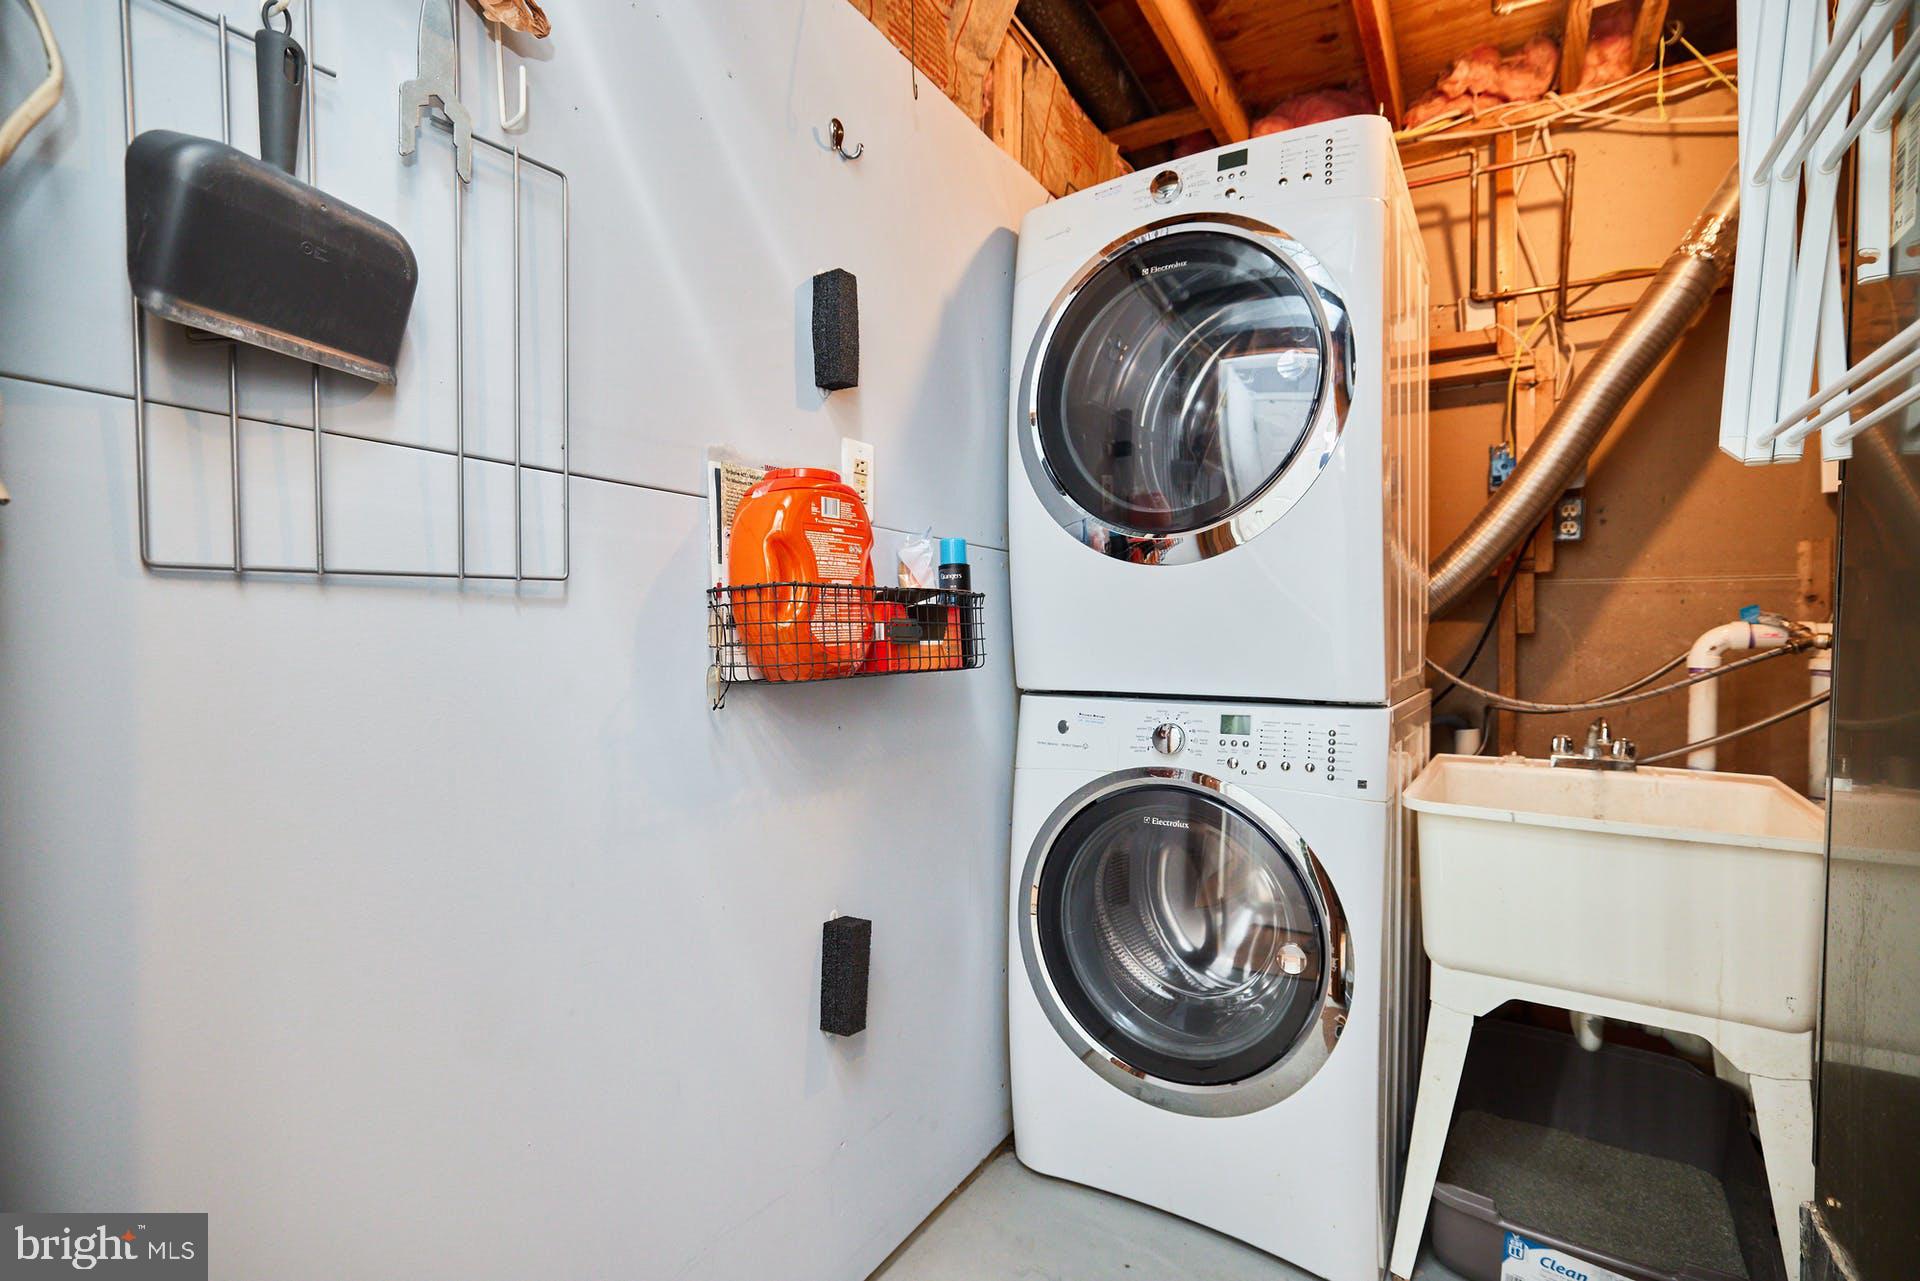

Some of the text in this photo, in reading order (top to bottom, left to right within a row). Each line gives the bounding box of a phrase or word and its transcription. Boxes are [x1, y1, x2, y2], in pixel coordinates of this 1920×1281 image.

[1150, 261, 1187, 273] Electrolux
[1151, 817, 1190, 828] Electrolux
[1540, 1257, 1588, 1281] Clean
